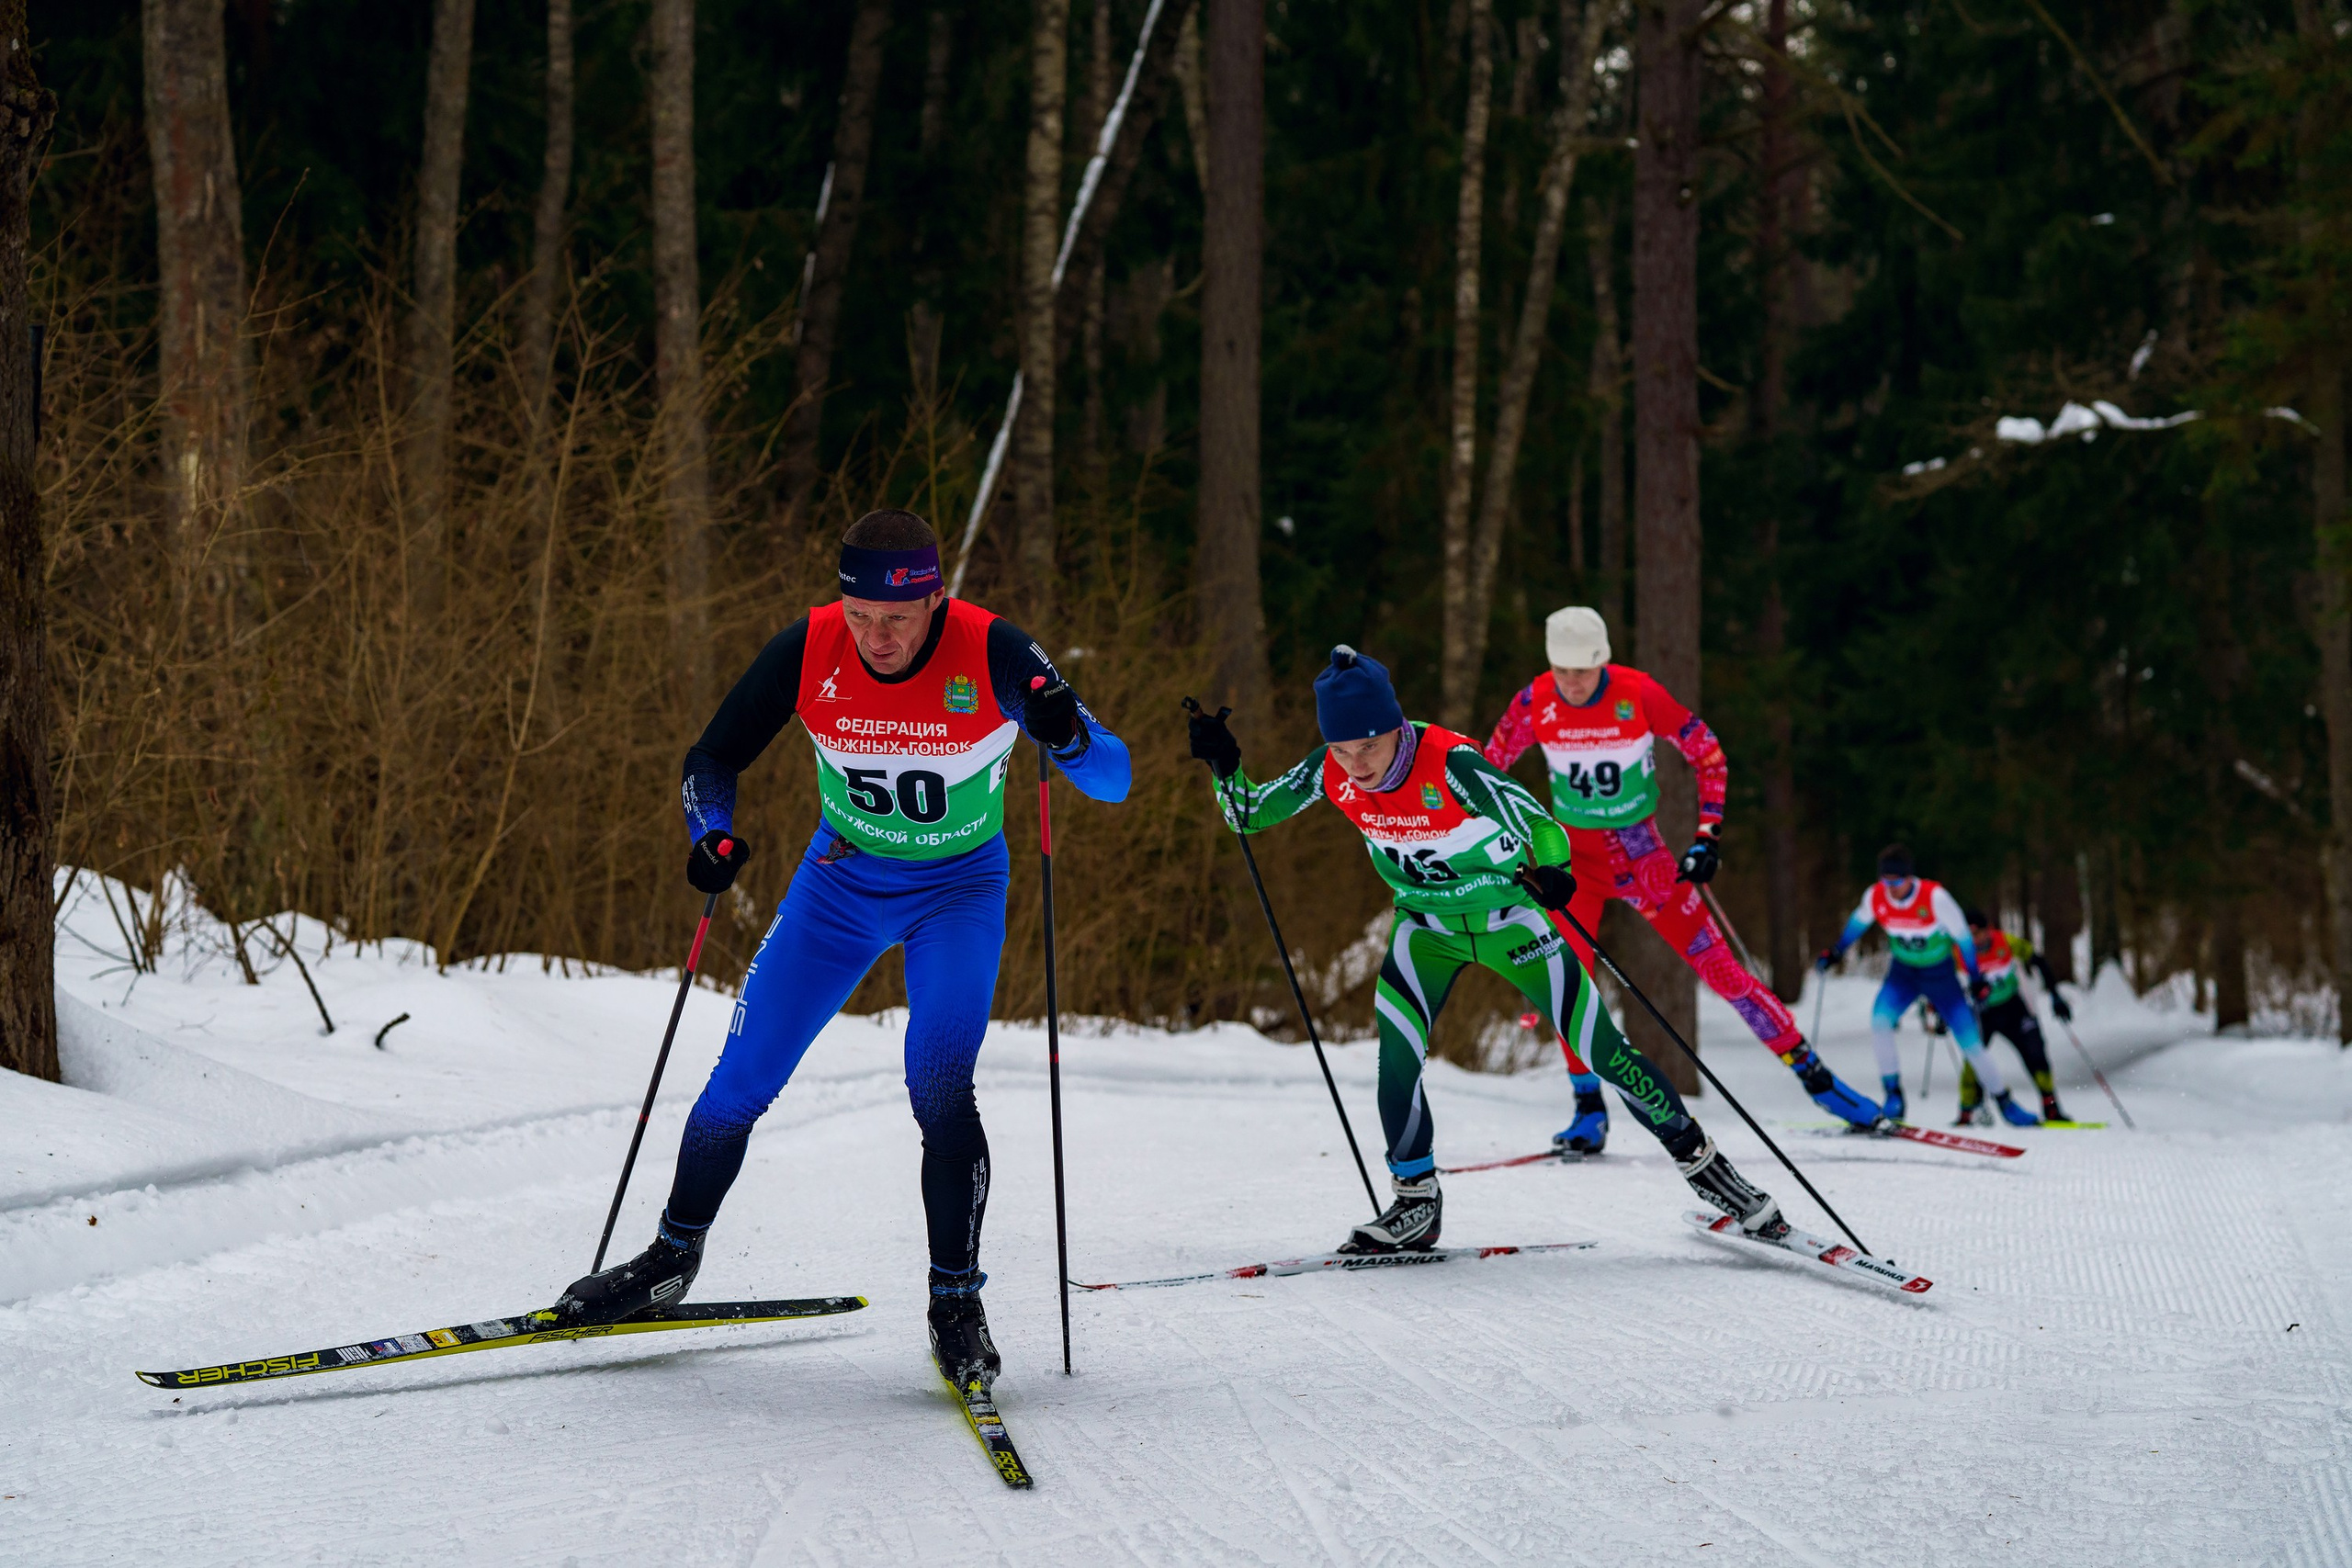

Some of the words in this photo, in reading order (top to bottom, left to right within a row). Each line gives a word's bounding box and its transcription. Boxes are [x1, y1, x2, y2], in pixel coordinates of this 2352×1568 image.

[835, 716, 948, 739] ФЕДЕРАЦИЯ
[815, 732, 903, 755] ЛЫЖНЫХ
[908, 739, 973, 757] ГОНОК
[1568, 761, 1622, 799] 49
[842, 765, 949, 825] 50
[822, 792, 909, 844] КАЛУЖСКОЙ
[915, 811, 988, 846] ОБЛАСТИ
[700, 840, 719, 864] Roeckl
[1608, 1046, 1677, 1125] RUSSIA
[1390, 1201, 1437, 1234] NANO
[1399, 1202, 1427, 1220] SUPER
[1341, 1255, 1448, 1268] MADSHUS
[1854, 1258, 1907, 1282] MADSHUS
[527, 1324, 615, 1344] FISCHER
[176, 1351, 321, 1385] FISCHER
